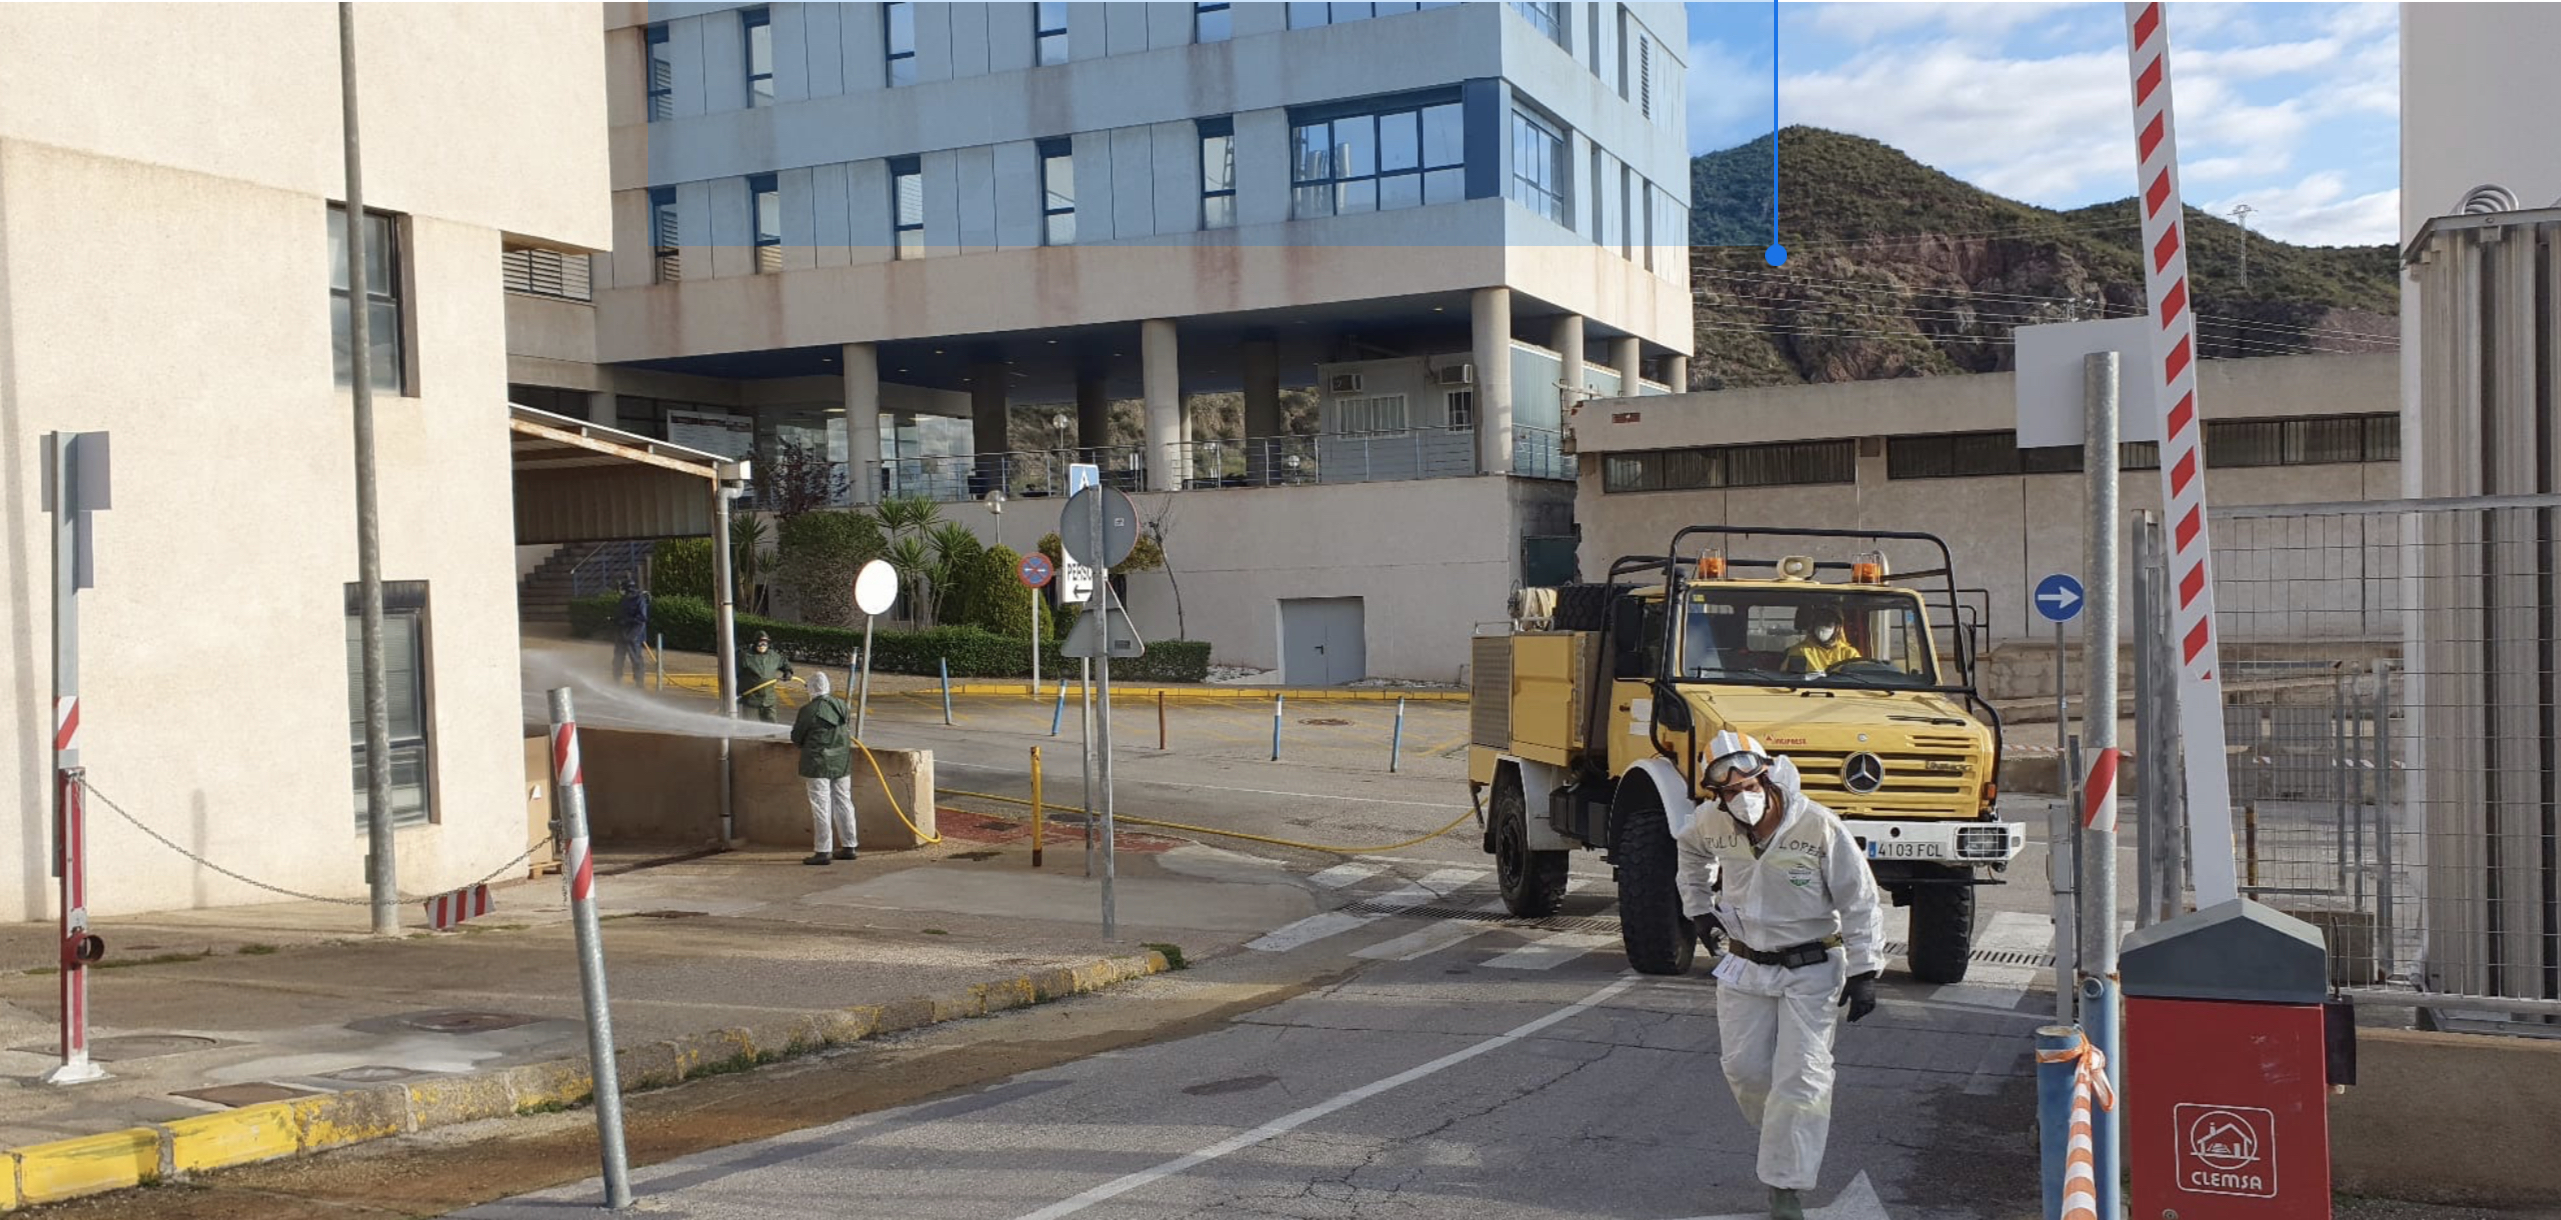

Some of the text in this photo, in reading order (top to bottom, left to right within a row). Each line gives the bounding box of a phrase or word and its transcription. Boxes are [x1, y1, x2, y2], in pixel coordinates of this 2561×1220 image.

[1879, 843, 1943, 857] 4103 FCL
[2191, 1171, 2263, 1191] CLEMSA
